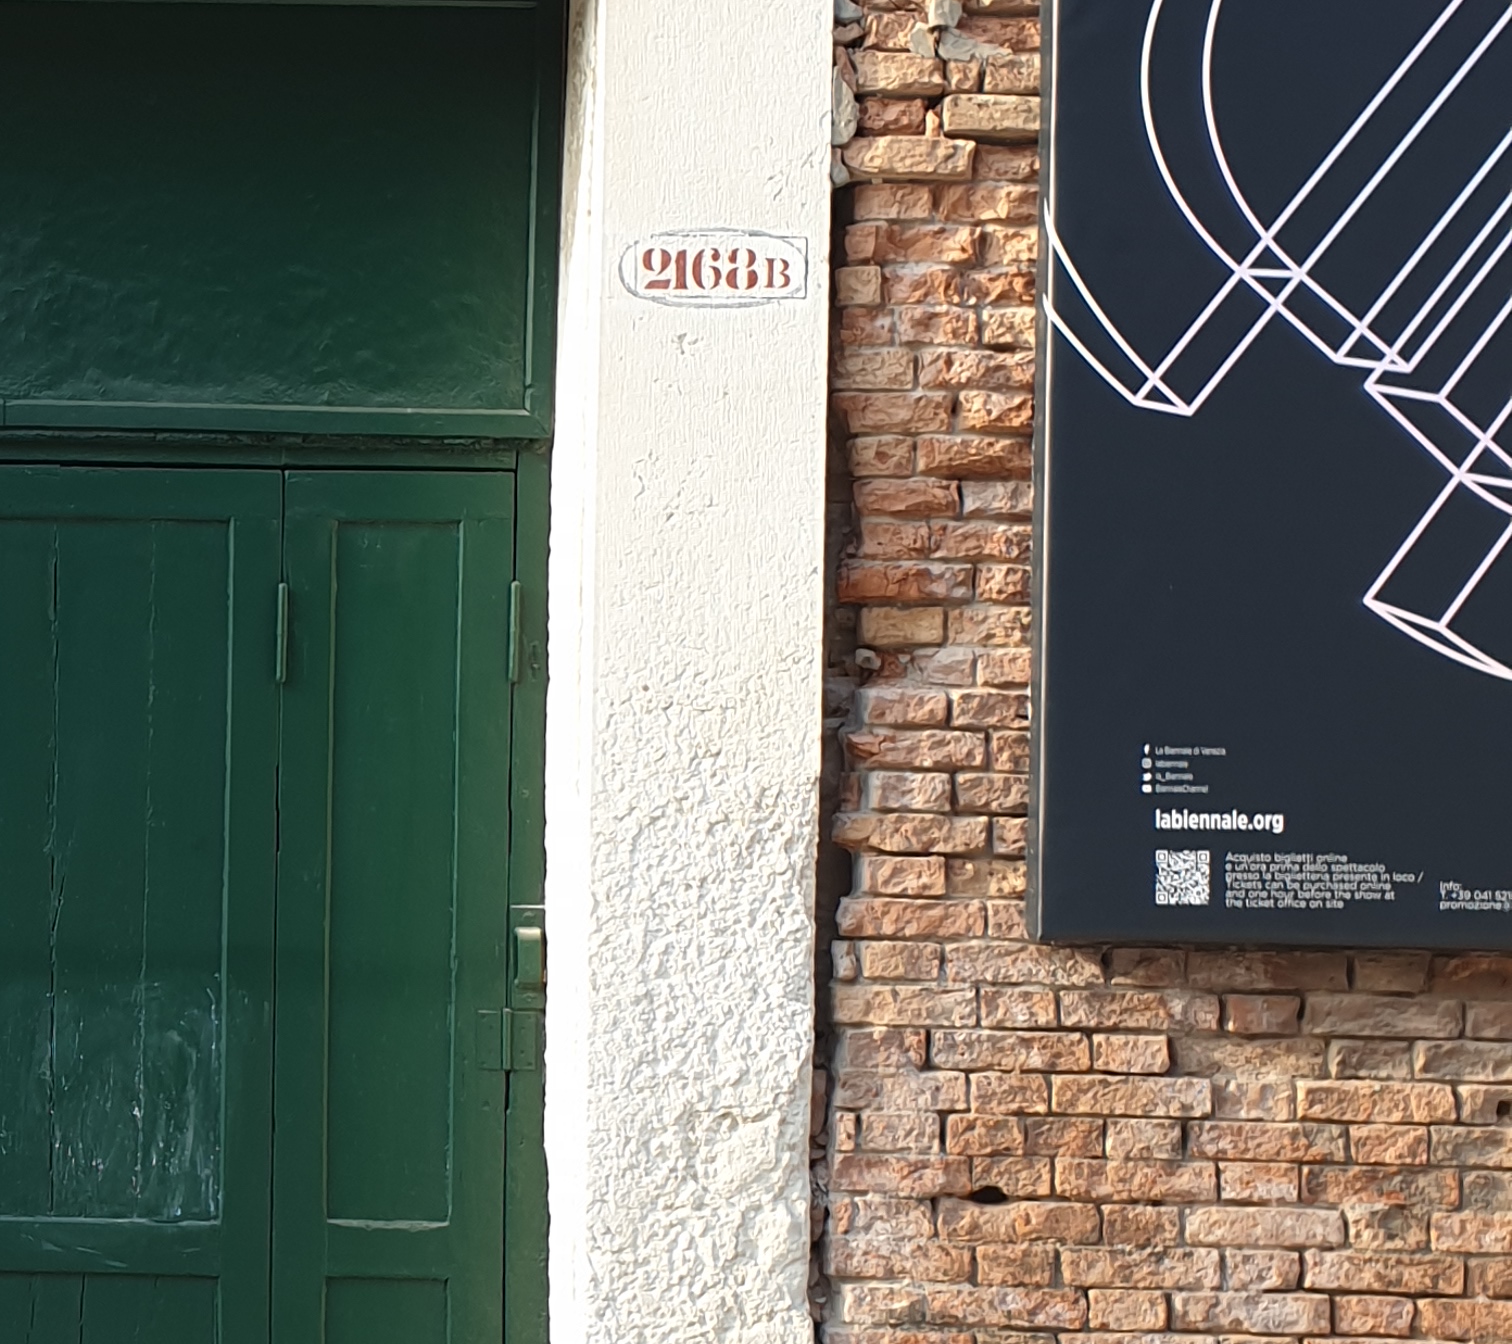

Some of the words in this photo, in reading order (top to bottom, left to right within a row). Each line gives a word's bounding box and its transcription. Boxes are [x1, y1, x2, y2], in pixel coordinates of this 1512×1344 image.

[1155, 808, 1284, 834] labiennale.org
[1225, 851, 1272, 864] Acquisto
[1274, 852, 1314, 864] biglietti
[1316, 852, 1348, 862] online
[1269, 863, 1301, 873] prima
[1331, 862, 1386, 873] spettacolo
[1225, 872, 1260, 883] presso
[1274, 872, 1330, 883] biglietteria
[1332, 873, 1378, 883] presente
[1380, 872, 1390, 882] in
[1393, 871, 1416, 882] loco
[1226, 880, 1262, 890] Tickets
[1265, 881, 1284, 890] can
[1286, 881, 1300, 890] be
[1303, 881, 1357, 892] purchased
[1360, 881, 1392, 891] online
[1225, 890, 1245, 899] and
[1248, 891, 1268, 899] one
[1270, 889, 1295, 900] hour
[1297, 889, 1332, 900] before
[1334, 890, 1352, 900] the
[1354, 891, 1382, 900] show
[1384, 891, 1395, 901] at
[1473, 890, 1492, 901] 041
[1494, 890, 1512, 902] 521
[1225, 898, 1243, 908] the
[1245, 898, 1275, 908] ticket
[1276, 898, 1307, 908] office
[1309, 899, 1324, 909] on
[1325, 899, 1345, 909] site
